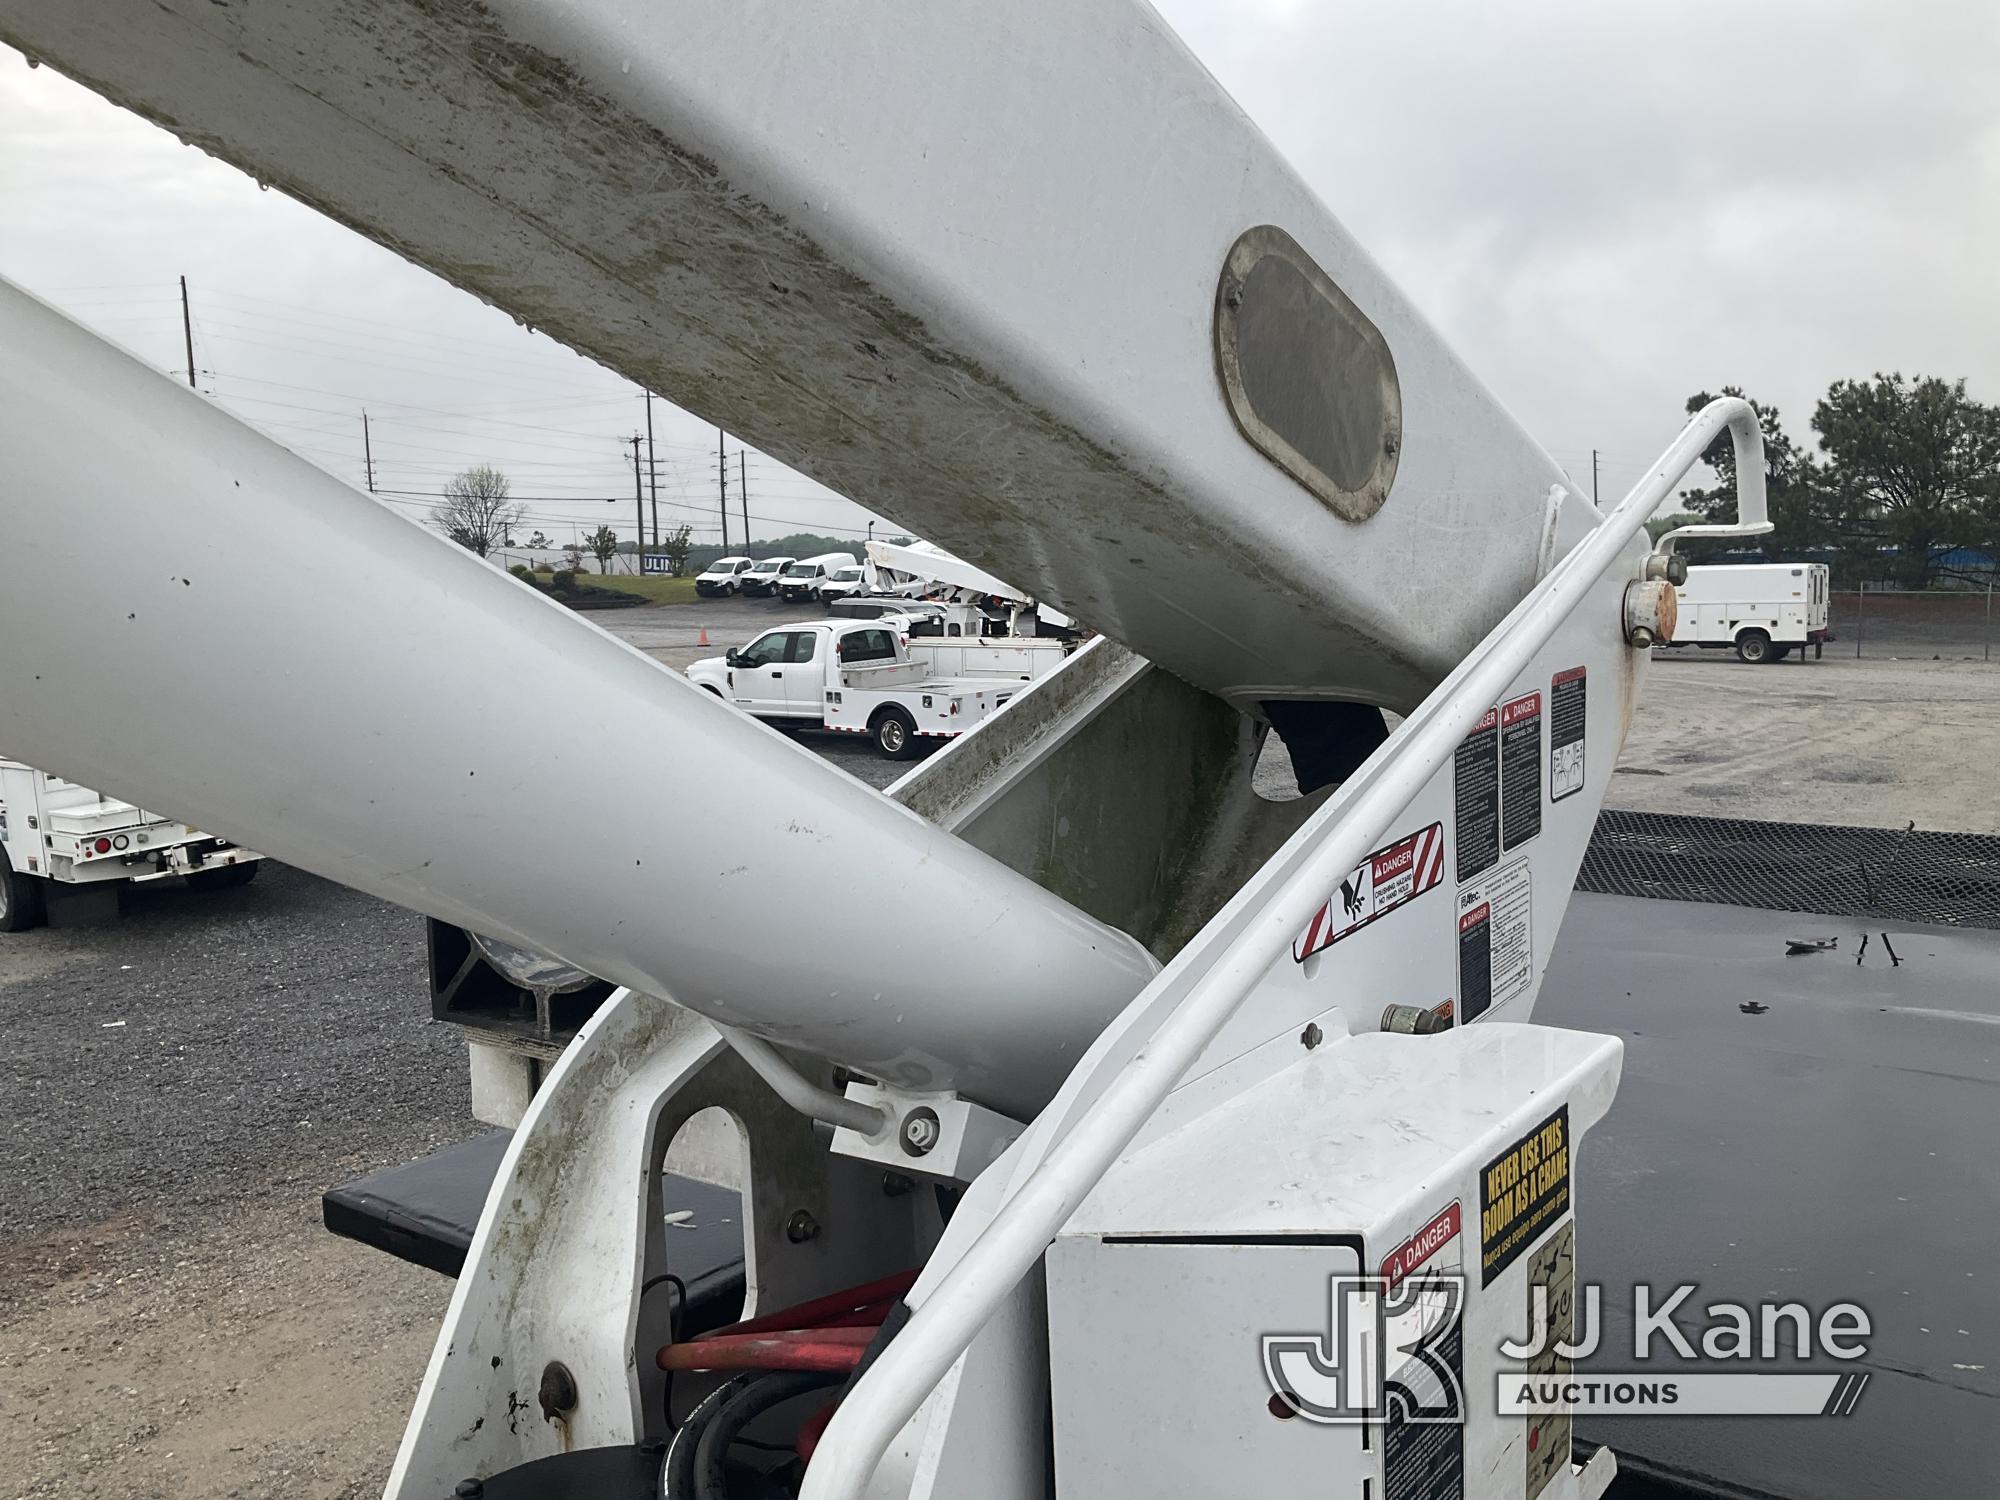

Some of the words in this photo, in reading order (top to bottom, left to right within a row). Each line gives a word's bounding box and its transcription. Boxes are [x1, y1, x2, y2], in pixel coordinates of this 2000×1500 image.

[1513, 698, 1536, 717] DANGER
[1381, 850, 1412, 875] DANGER
[1375, 882, 1396, 899] CRUSHING
[1395, 873, 1413, 889] HAZARD
[1378, 897, 1386, 905] NO
[1386, 889, 1398, 903] HAND
[1397, 883, 1409, 897] HOLD
[1467, 907, 1487, 925] DANGER
[1487, 1150, 1520, 1204] NEVER
[1520, 1135, 1540, 1176] USE
[1541, 1117, 1563, 1160] THIS
[1482, 1189, 1514, 1244] BOOM
[1515, 1177, 1528, 1218] AS
[1529, 1171, 1537, 1204] A
[1538, 1145, 1568, 1196] CRANE
[1405, 1216, 1451, 1268] DANGER
[1483, 1243, 1501, 1270] Nunca
[1501, 1235, 1512, 1254] use
[1512, 1219, 1530, 1244] equipo
[1542, 1197, 1555, 1217] como
